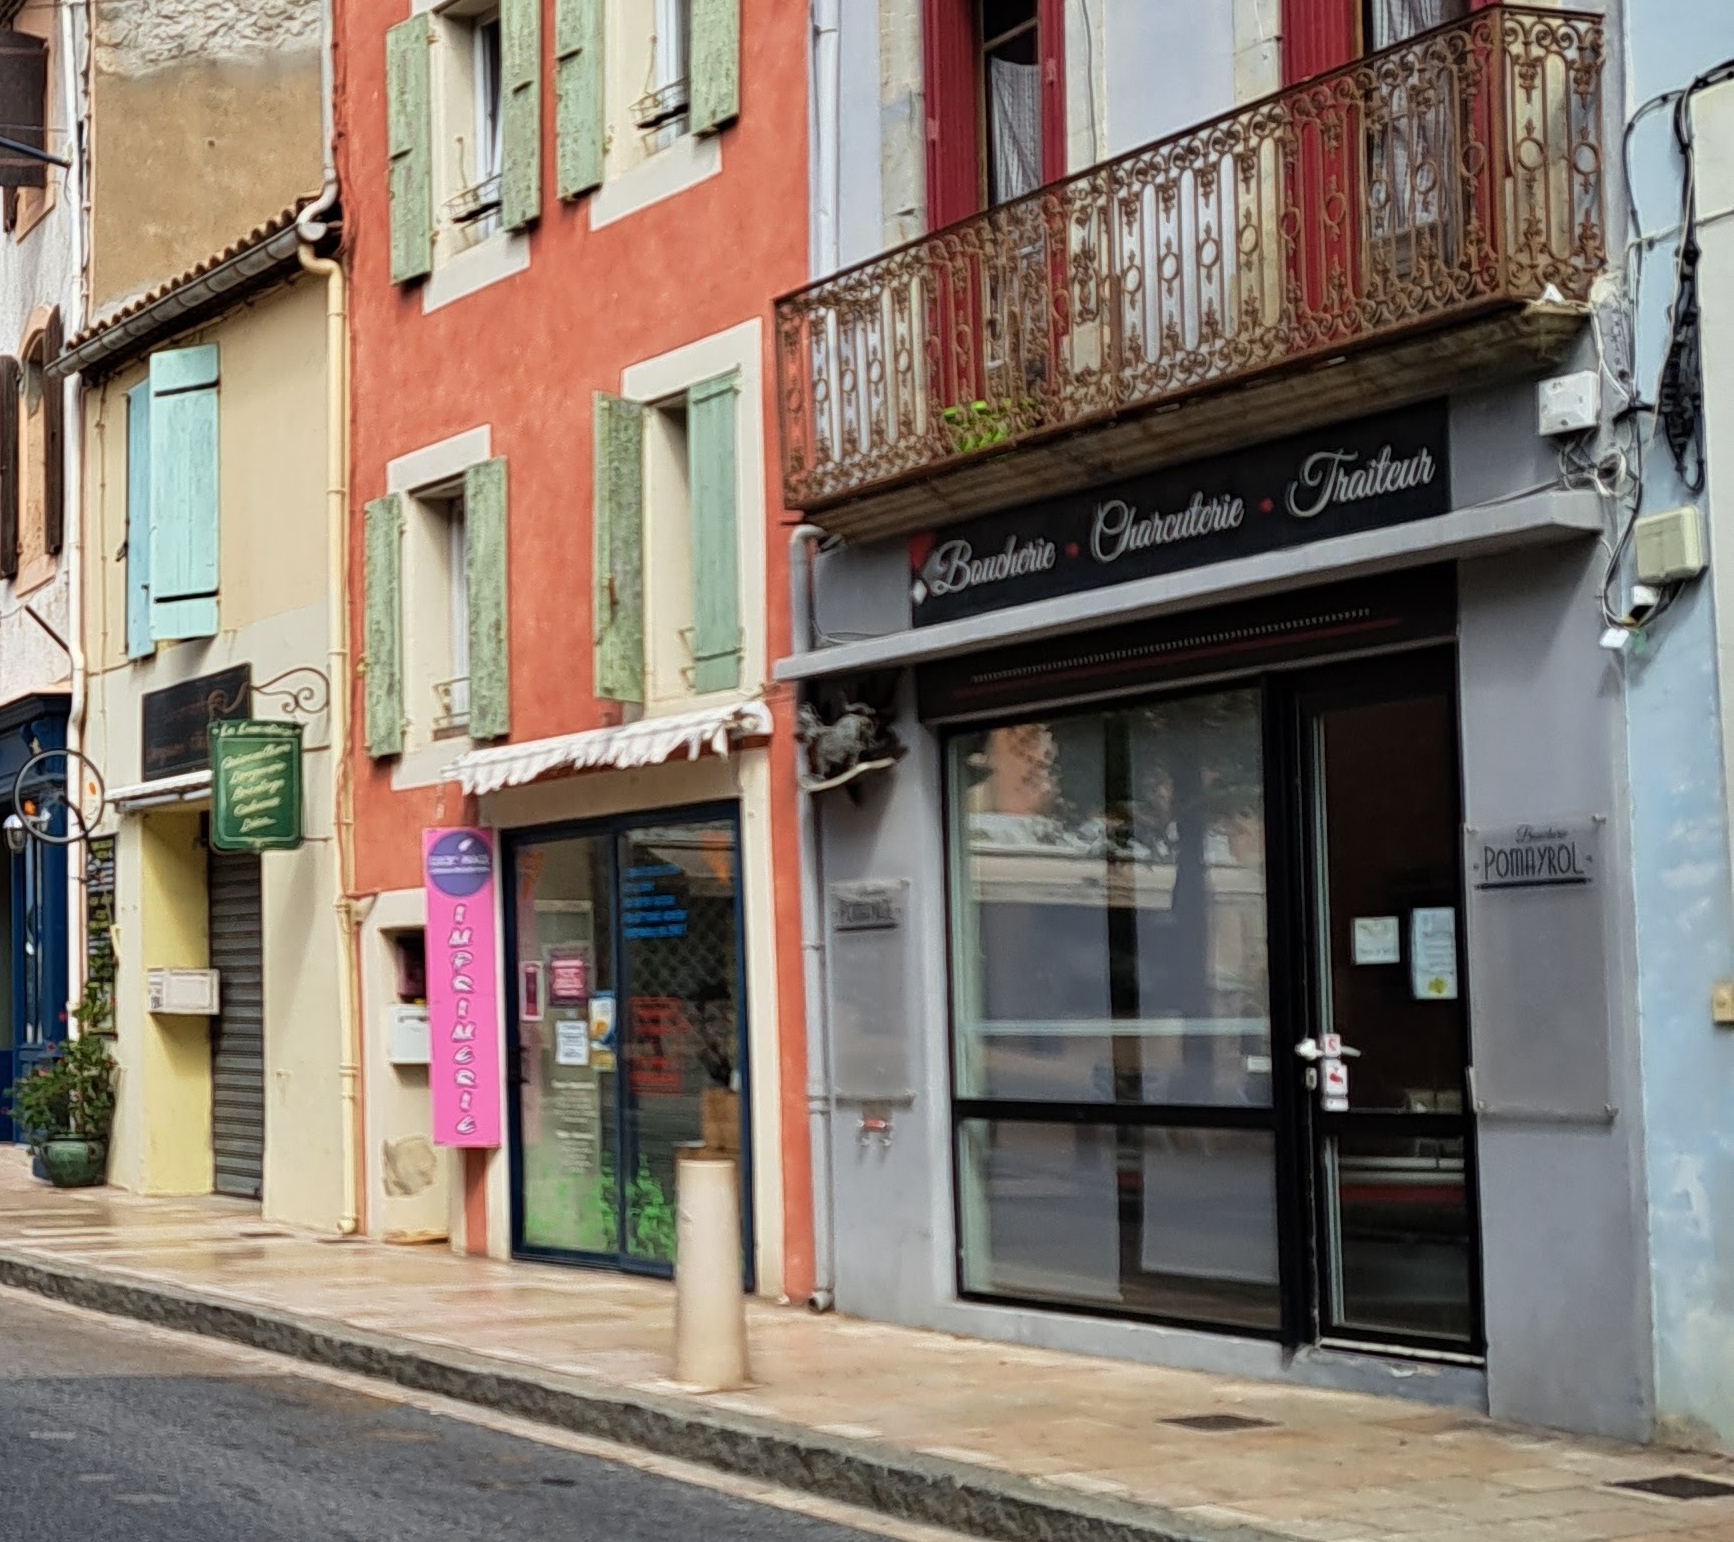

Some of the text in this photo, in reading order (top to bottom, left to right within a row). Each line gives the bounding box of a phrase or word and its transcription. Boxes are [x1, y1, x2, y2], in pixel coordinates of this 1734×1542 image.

[929, 444, 1438, 598] Boucherie Charcuterie Traiteur
[1484, 841, 1585, 881] POMAYROL
[448, 903, 478, 1136] IMPRIMERIE
